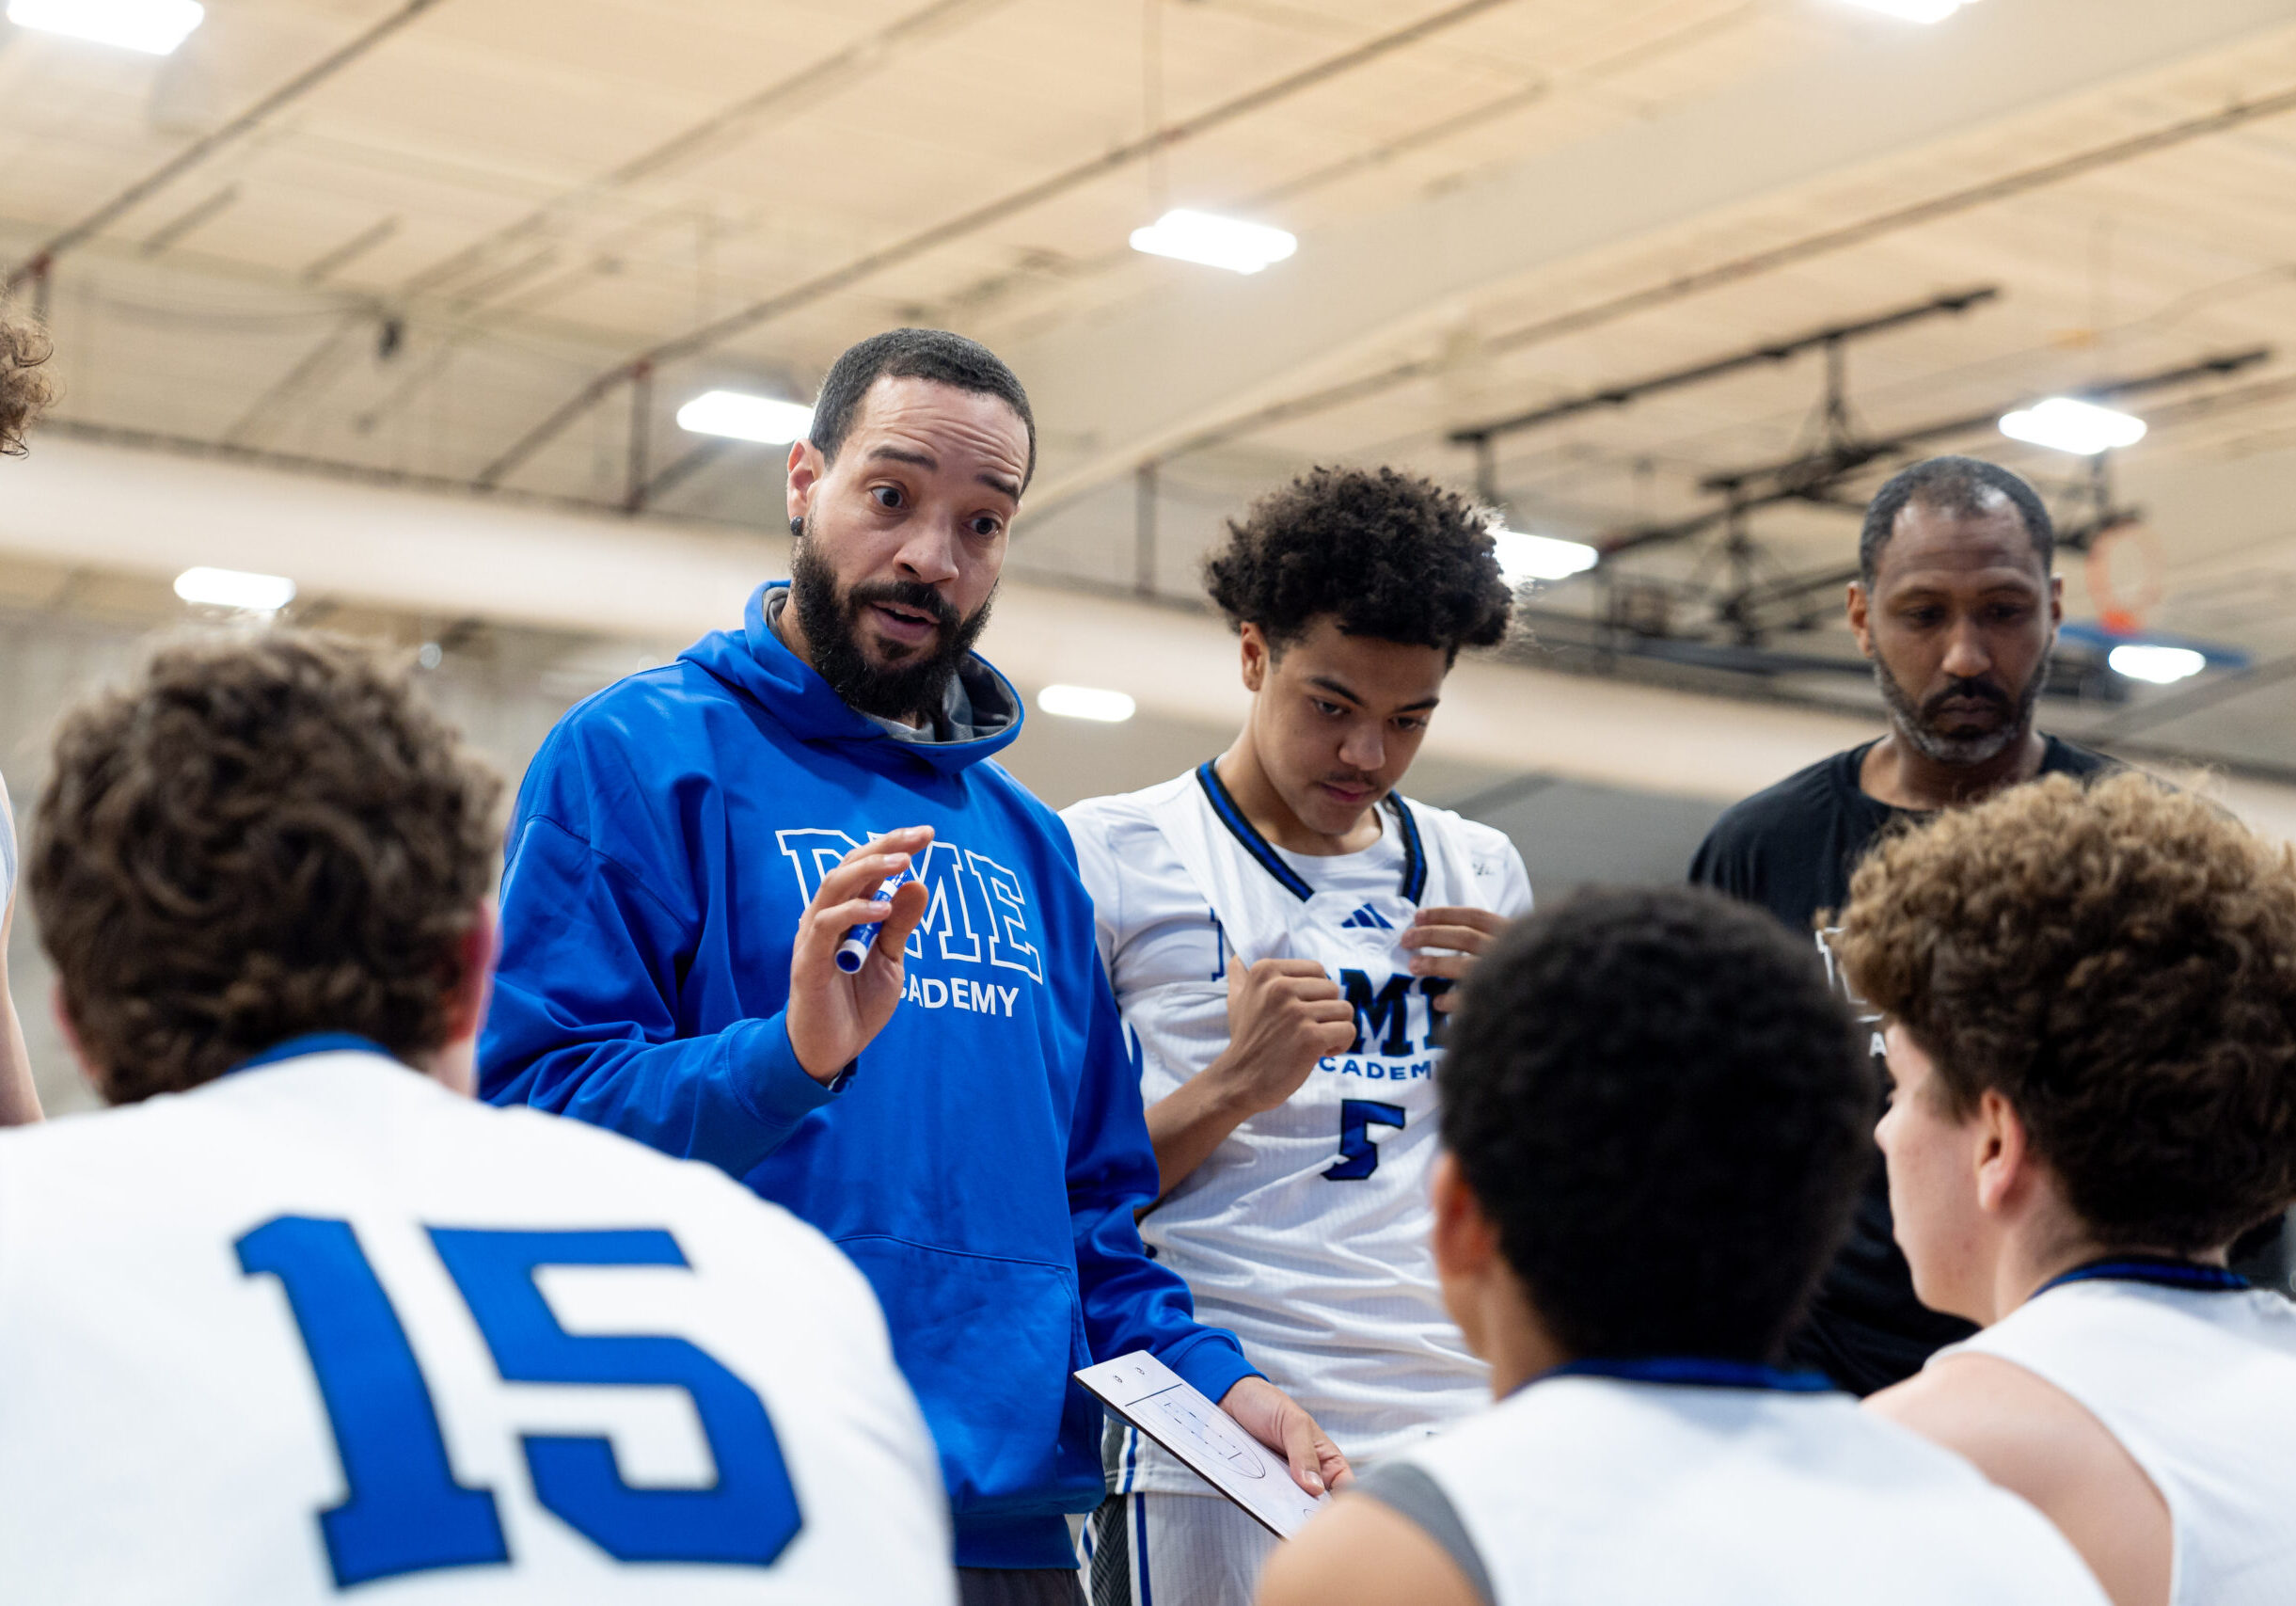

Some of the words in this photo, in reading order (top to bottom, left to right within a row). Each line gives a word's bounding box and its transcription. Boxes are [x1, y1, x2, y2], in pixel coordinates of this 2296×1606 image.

[899, 973, 1019, 1017] ADEMY
[1319, 1057, 1432, 1080] CADEM
[1320, 1099, 1405, 1181] 5
[231, 1215, 805, 1589] 15
